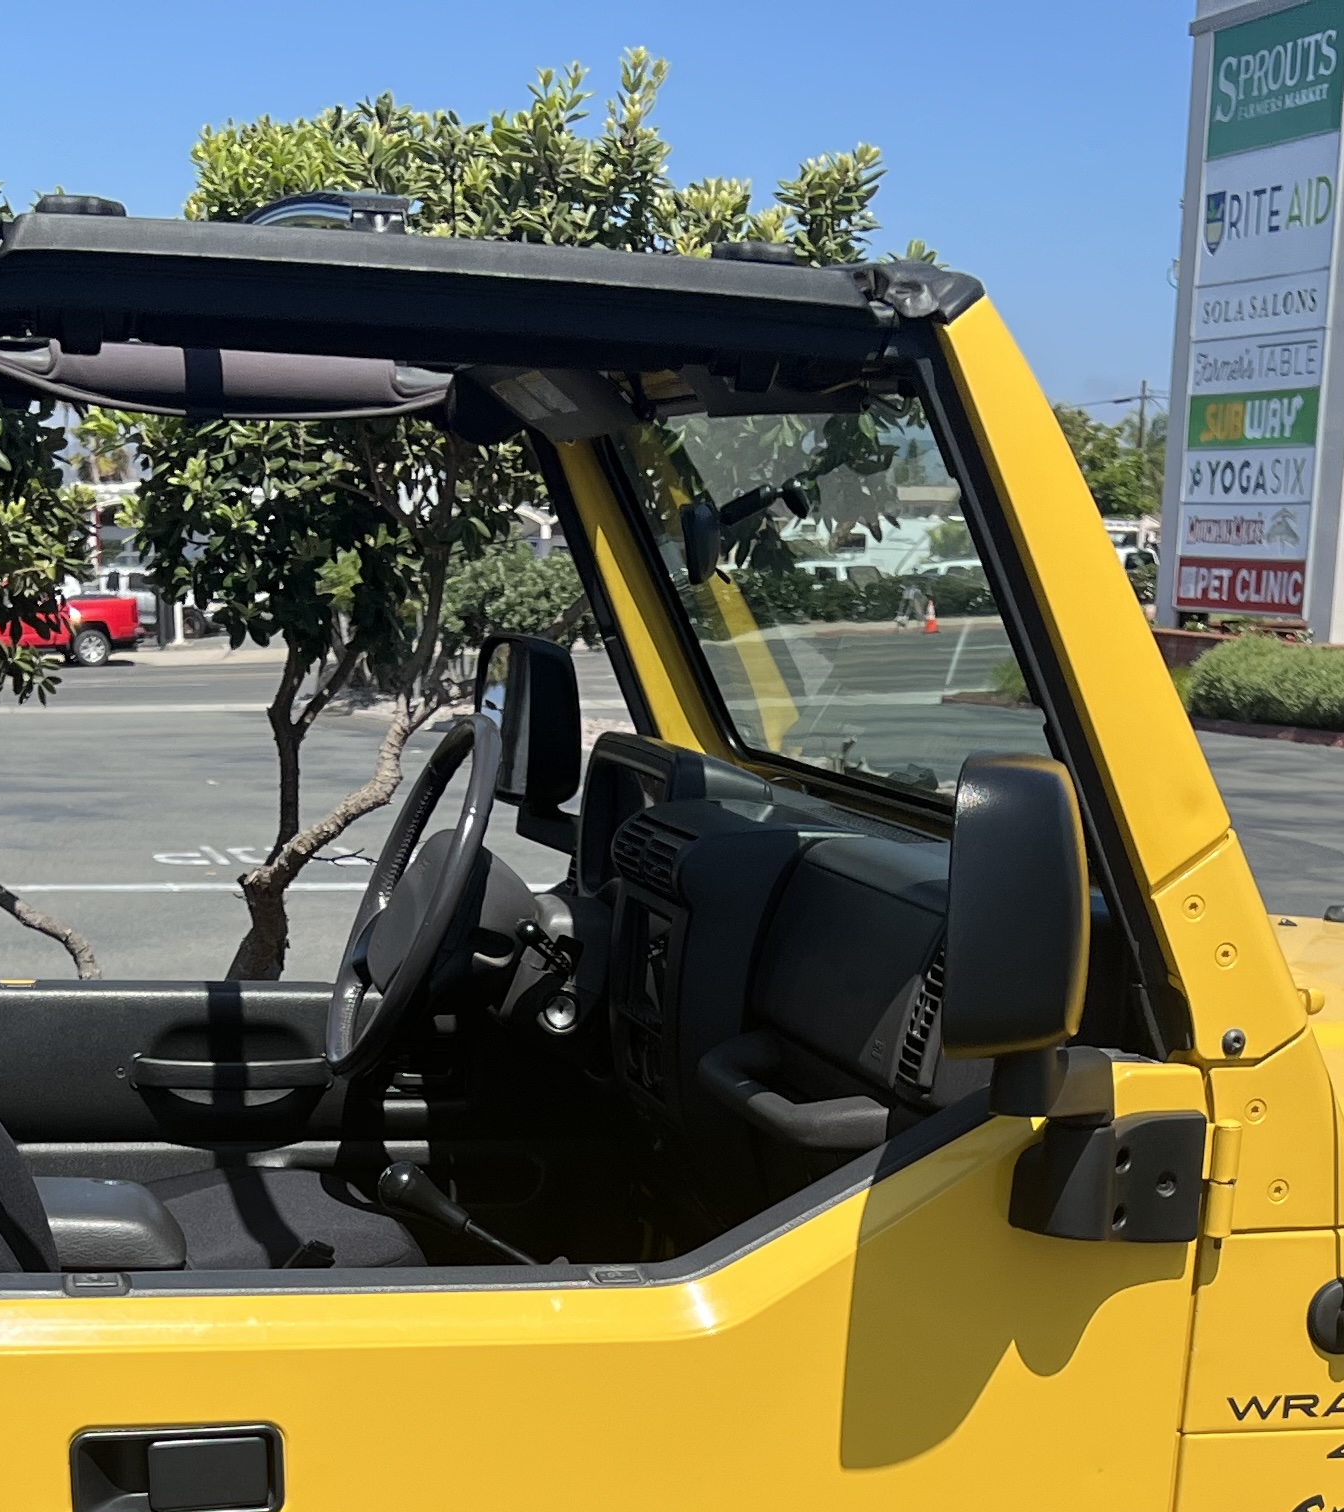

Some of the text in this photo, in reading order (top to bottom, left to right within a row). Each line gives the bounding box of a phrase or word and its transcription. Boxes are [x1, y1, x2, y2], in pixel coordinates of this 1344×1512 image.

[1215, 29, 1337, 122] SPROUTS
[1284, 83, 1329, 109] MARKET
[1227, 175, 1333, 241] RITE AID
[1202, 288, 1318, 325] SOLA SALONS
[1256, 339, 1319, 379] TABLE
[1199, 393, 1305, 442] SUBWAY
[1196, 566, 1303, 606] PET CLINIC
